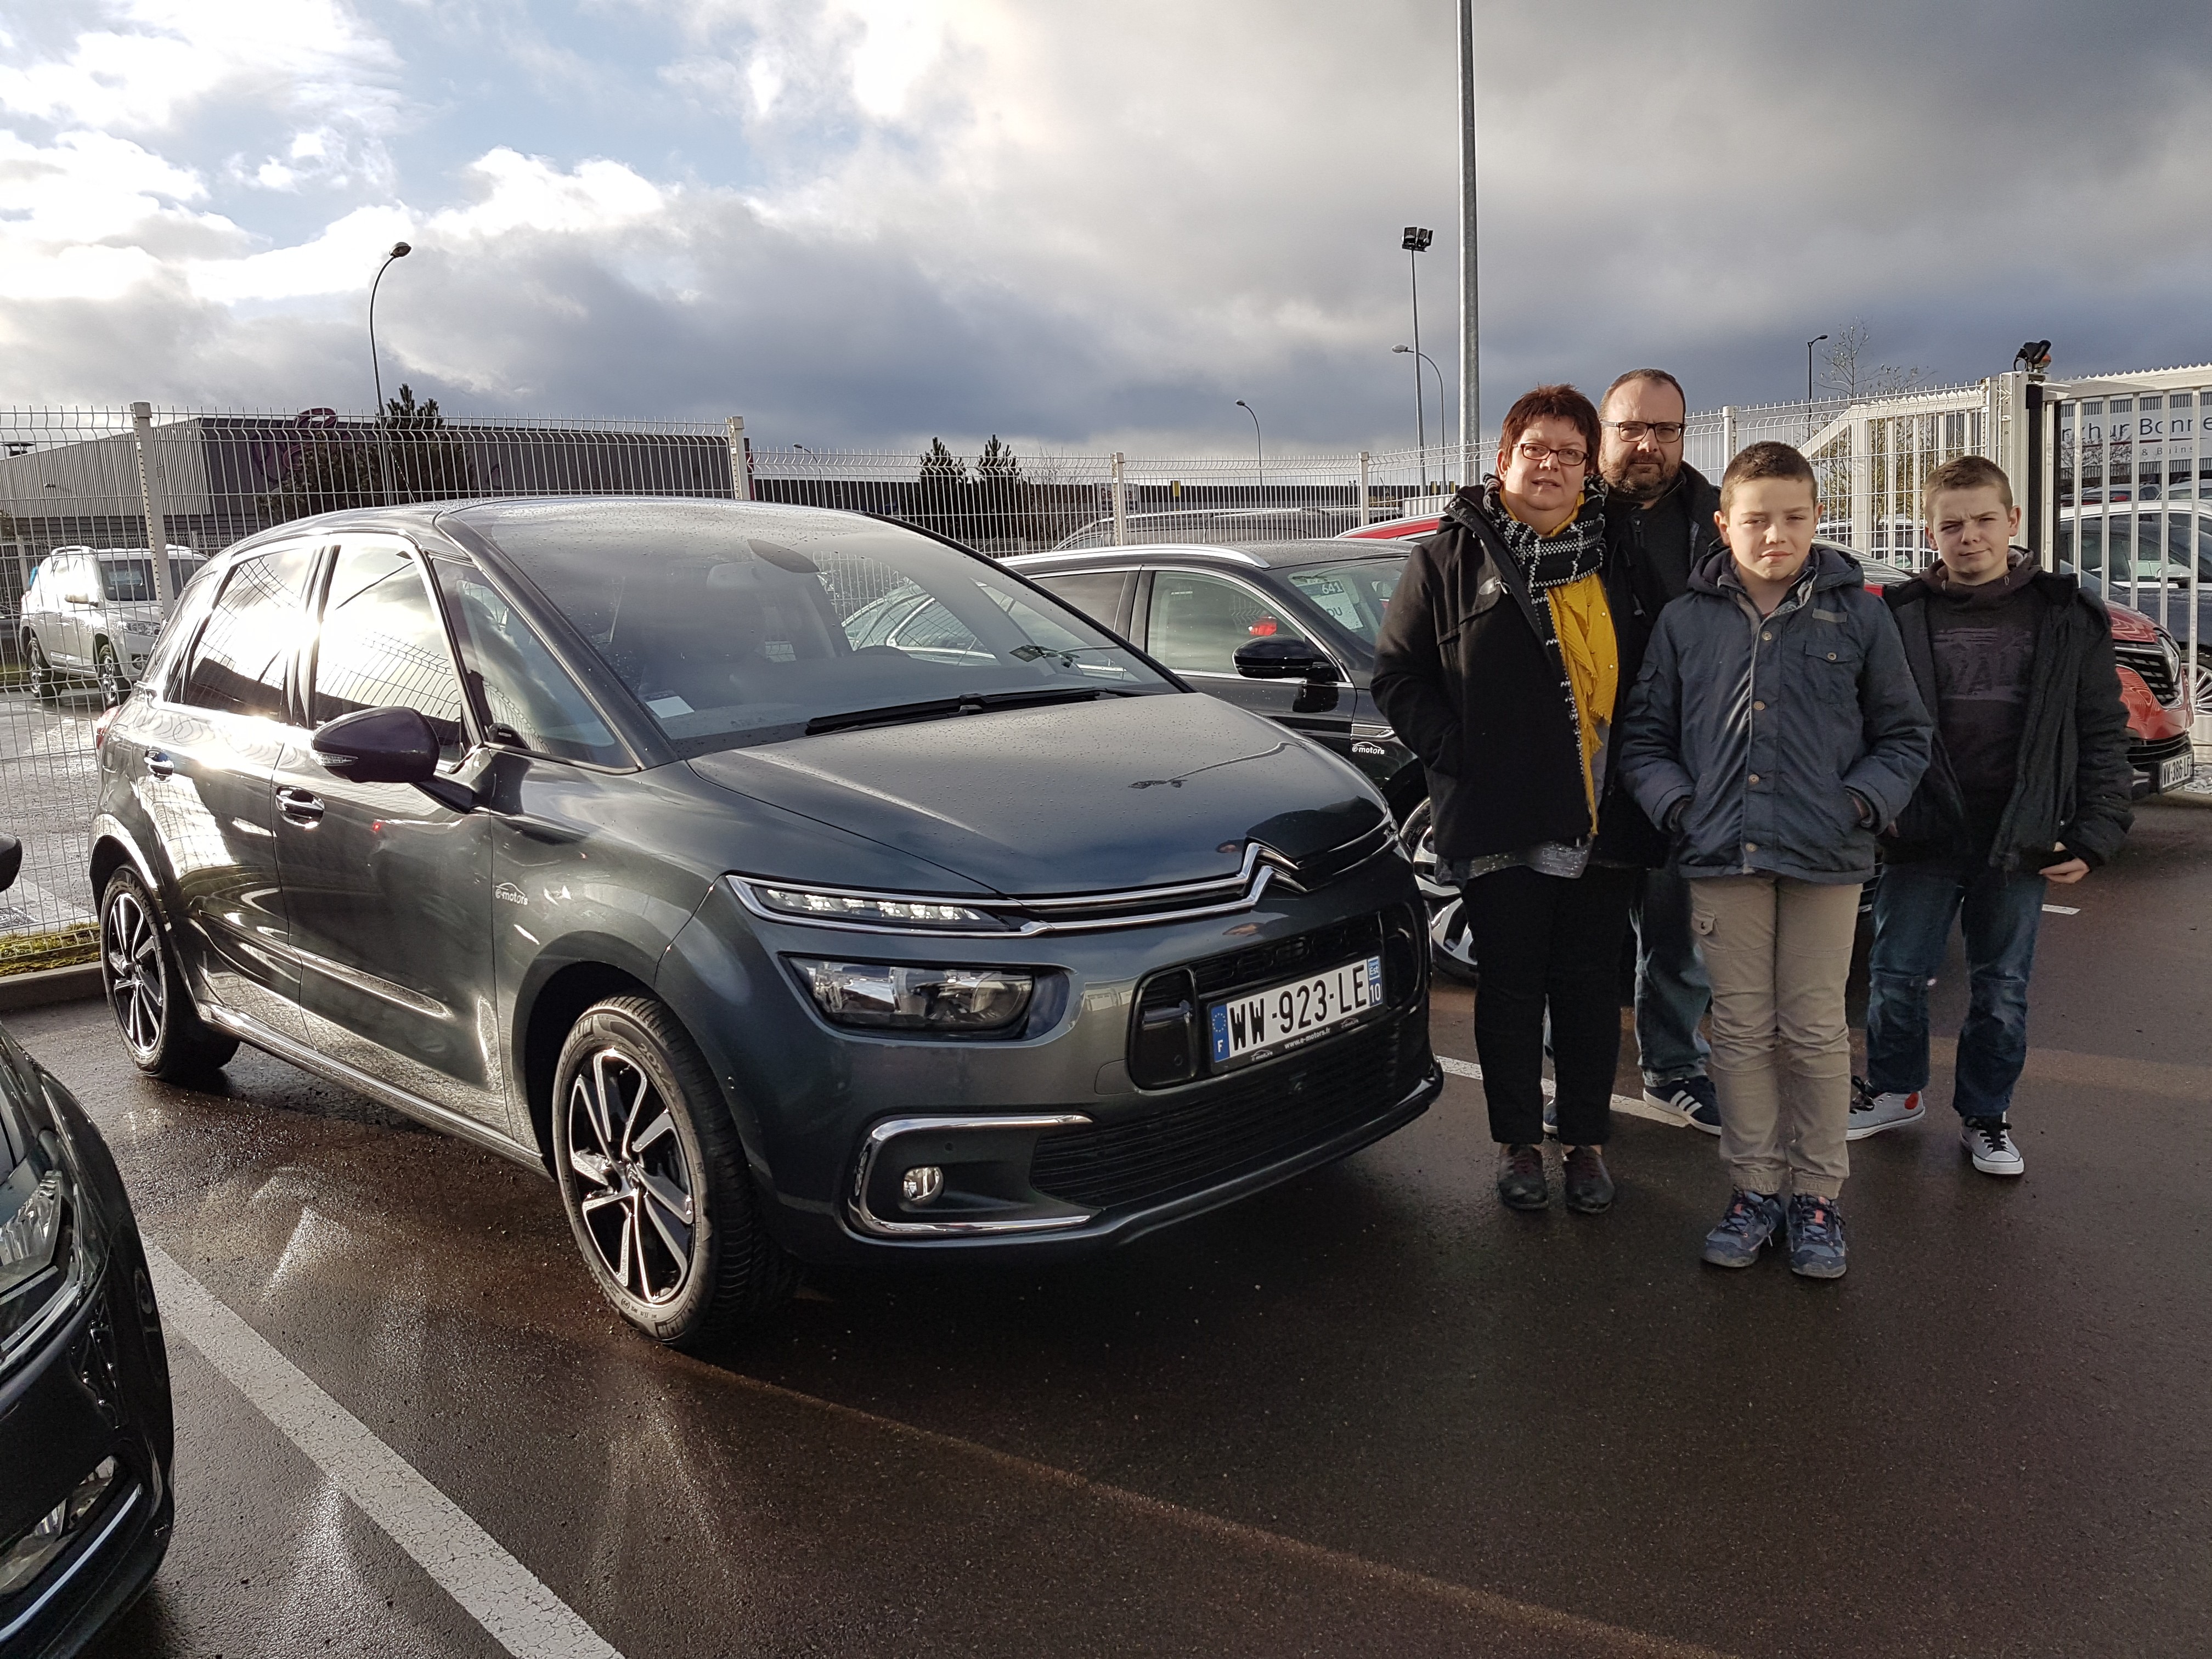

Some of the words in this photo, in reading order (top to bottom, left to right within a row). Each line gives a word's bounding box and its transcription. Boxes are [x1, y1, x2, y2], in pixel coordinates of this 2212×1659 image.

[2157, 446, 2193, 455] Bins
[1322, 582, 1342, 594] 641
[1352, 746, 1385, 754] e-motors
[495, 888, 528, 905] e-motors
[1370, 983, 1381, 1003] 10
[1217, 1040, 1223, 1053] F
[1229, 964, 1367, 1051] WW-923-LE
[1284, 1027, 1330, 1049] www.e-motors.fr
